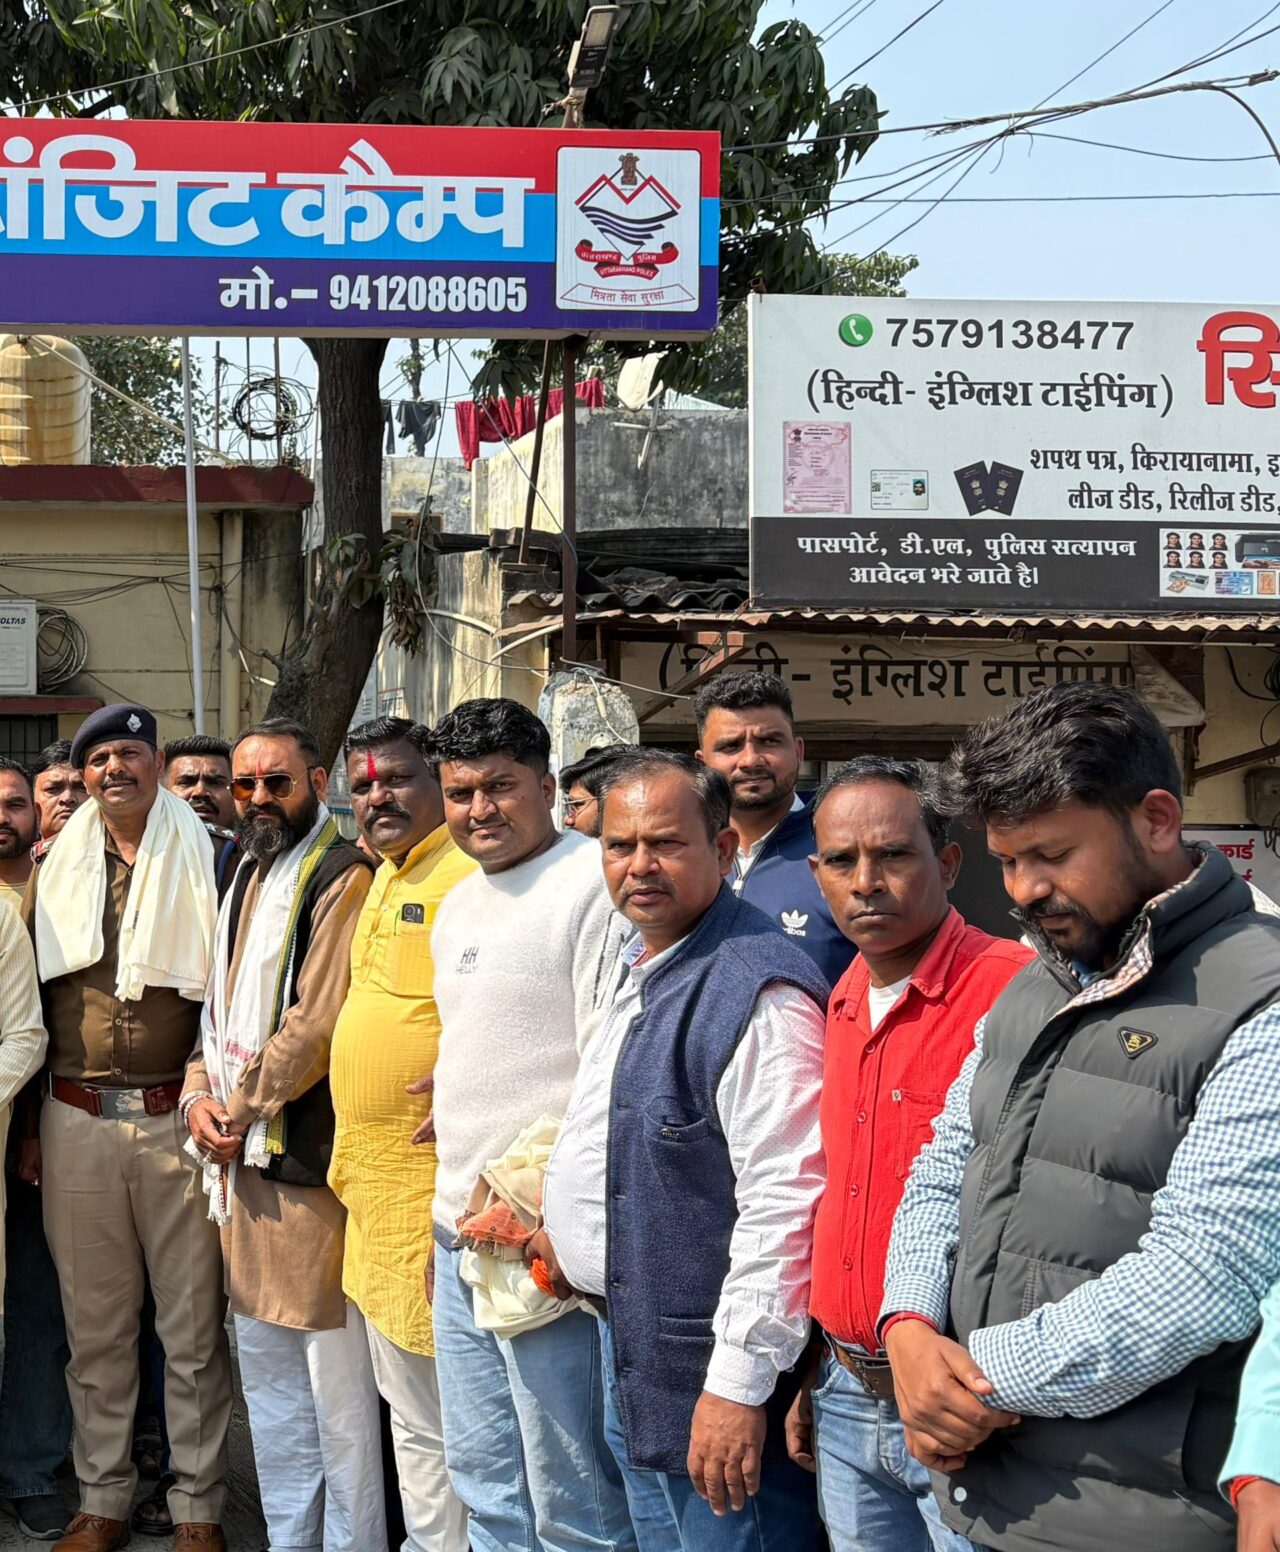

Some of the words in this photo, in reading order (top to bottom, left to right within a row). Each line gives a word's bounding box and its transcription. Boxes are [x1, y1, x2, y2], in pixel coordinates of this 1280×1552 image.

[277, 138, 535, 248] कैम्प
[328, 276, 528, 312] 9412088605
[591, 287, 616, 302] मित्रता
[621, 290, 636, 302] सेवा
[885, 317, 1136, 351] 7579138477
[926, 370, 1033, 410] इंग्लिश
[1040, 372, 1173, 418] टाईपिंग)
[1030, 447, 1082, 470] शपथ
[1086, 449, 1124, 475] पत्र,
[1131, 442, 1262, 475] किरायानामा,
[1067, 486, 1113, 510] लीज
[1119, 487, 1163, 514] डीड,
[1169, 486, 1235, 513] रिलीज
[797, 533, 888, 557] पासपोर्ट,
[985, 533, 1047, 561] पुलिस
[1051, 537, 1137, 557] सत्यापन
[848, 563, 925, 585] आवेदन
[930, 563, 964, 585] भरे
[967, 564, 1012, 585] जाते
[830, 644, 969, 705] इंग्लिश
